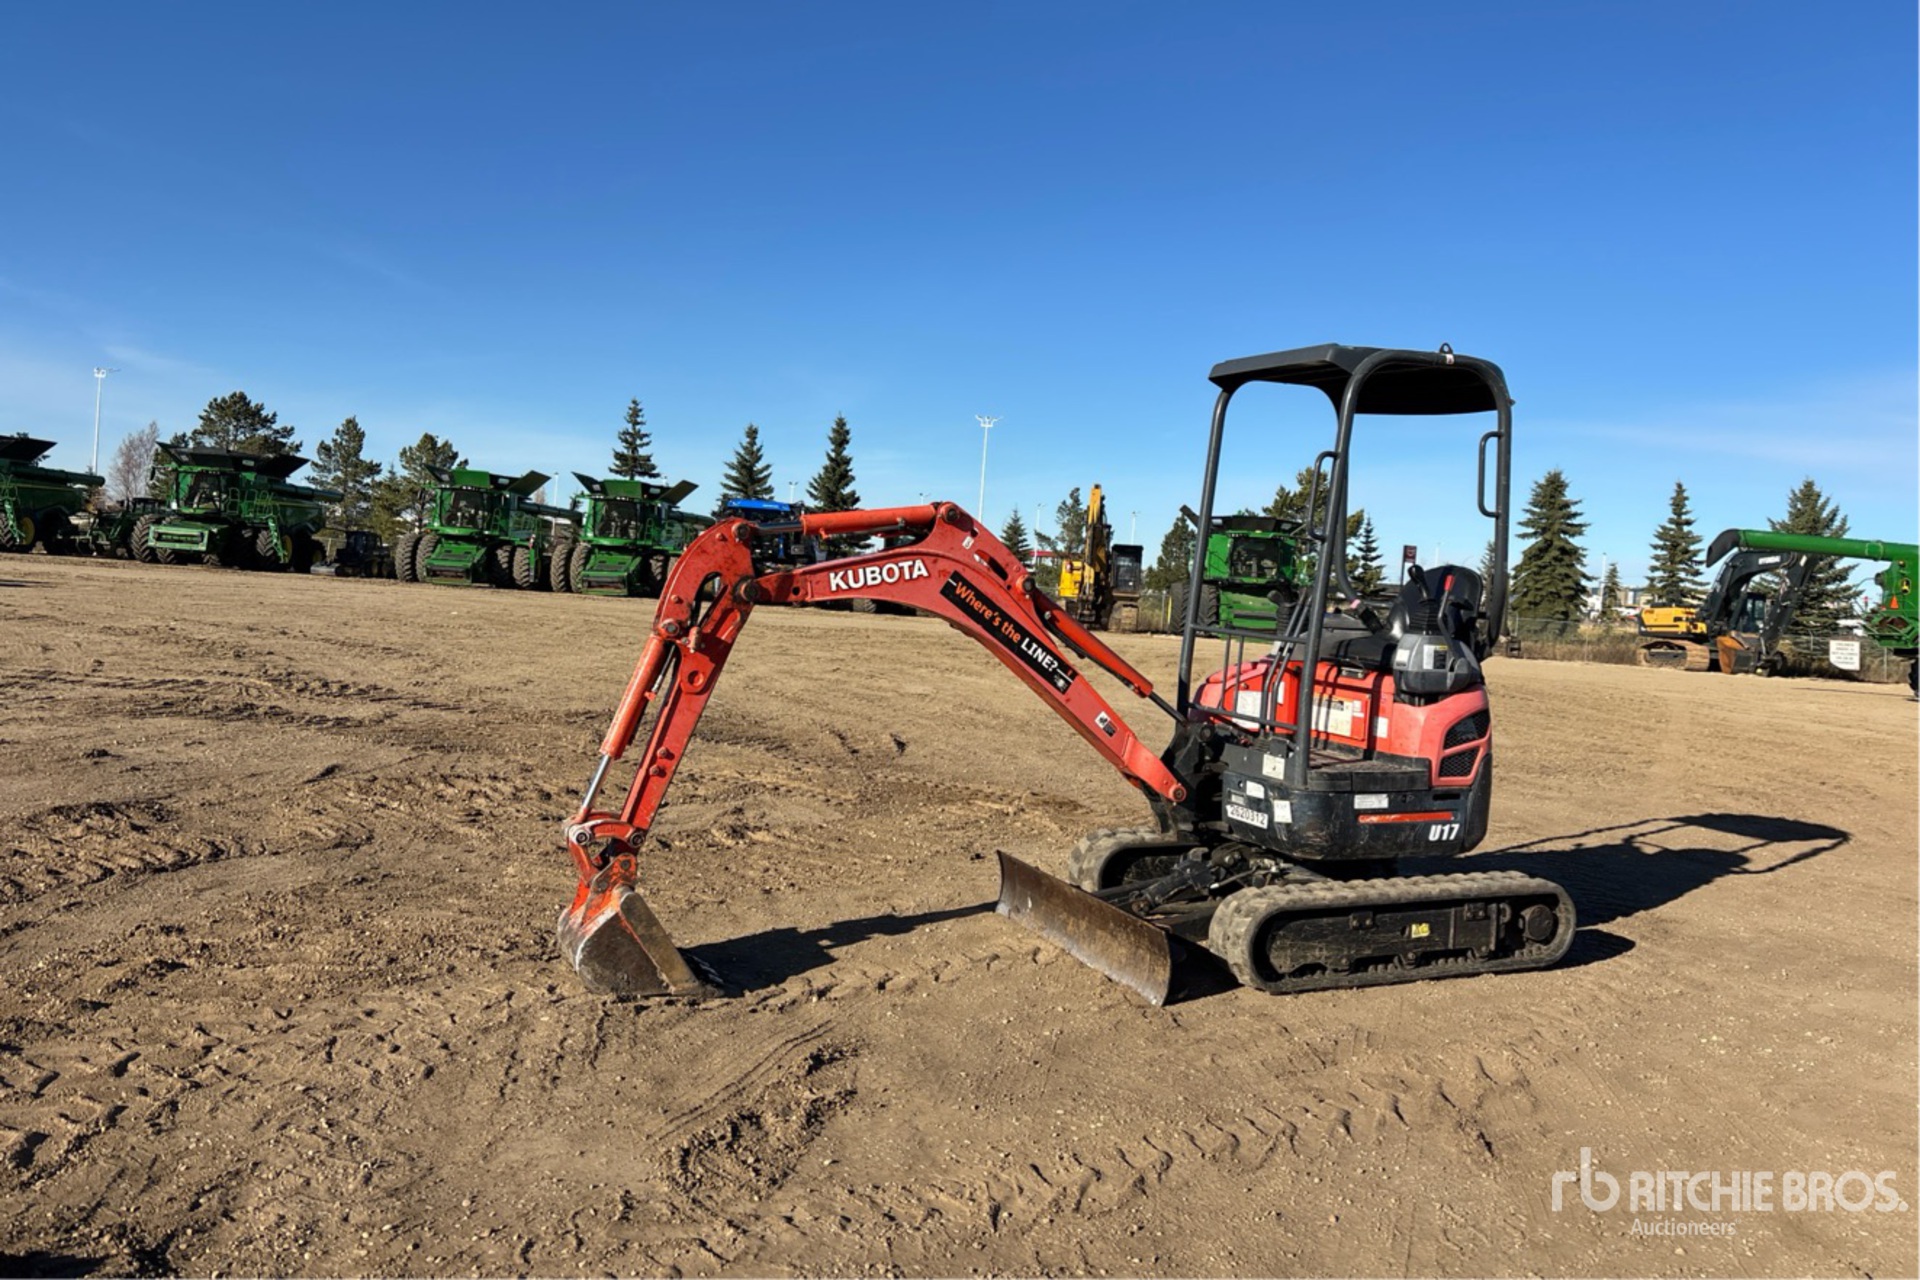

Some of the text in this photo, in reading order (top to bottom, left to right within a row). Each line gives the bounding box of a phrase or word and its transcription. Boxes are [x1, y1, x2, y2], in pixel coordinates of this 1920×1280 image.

[829, 559, 929, 592] KUBOTA
[955, 581, 1059, 672] Where's the LINE?
[1428, 823, 1460, 842] U17
